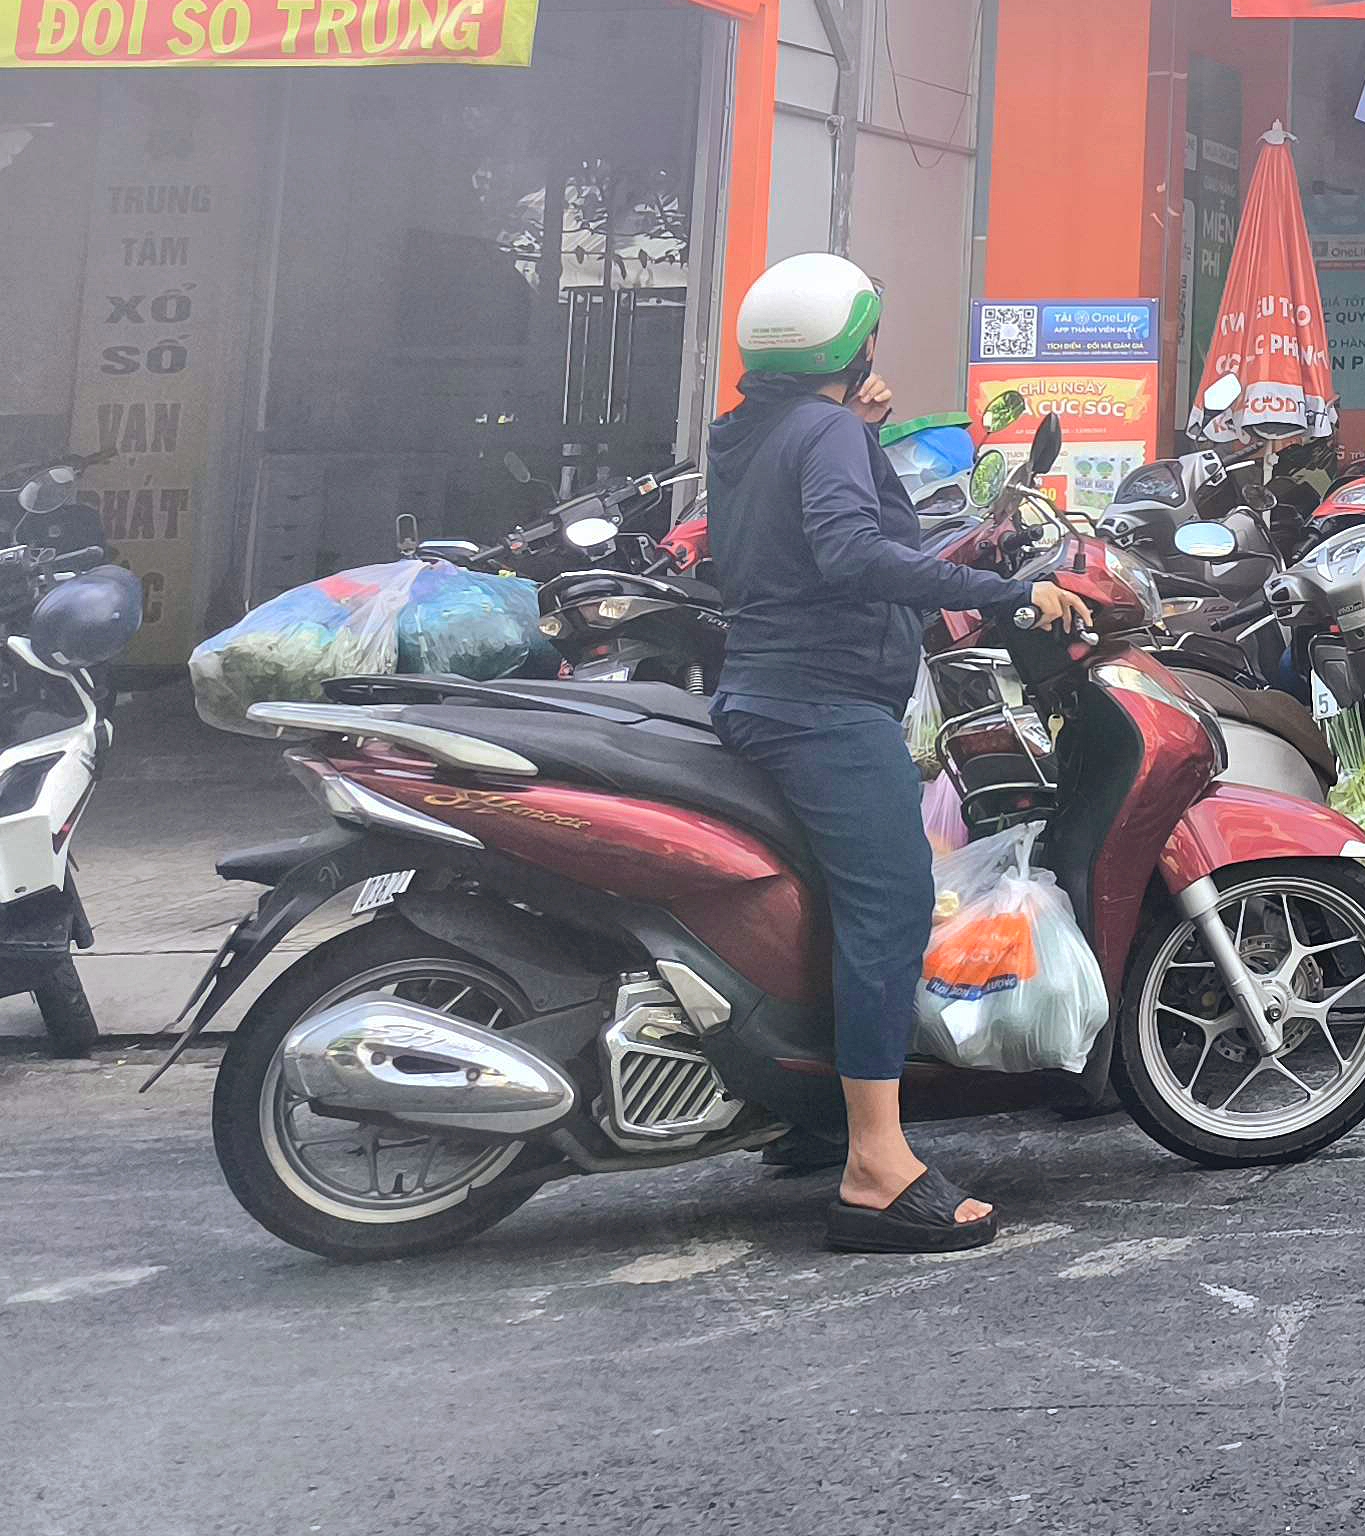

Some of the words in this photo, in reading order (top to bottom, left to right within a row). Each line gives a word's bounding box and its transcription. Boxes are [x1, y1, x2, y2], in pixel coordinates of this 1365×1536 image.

[108, 185, 211, 214] TRUNG
[105, 282, 197, 324] XỔ
[1092, 311, 1138, 323] OneLife
[101, 333, 191, 374] SỐ
[1048, 384, 1059, 395] 4
